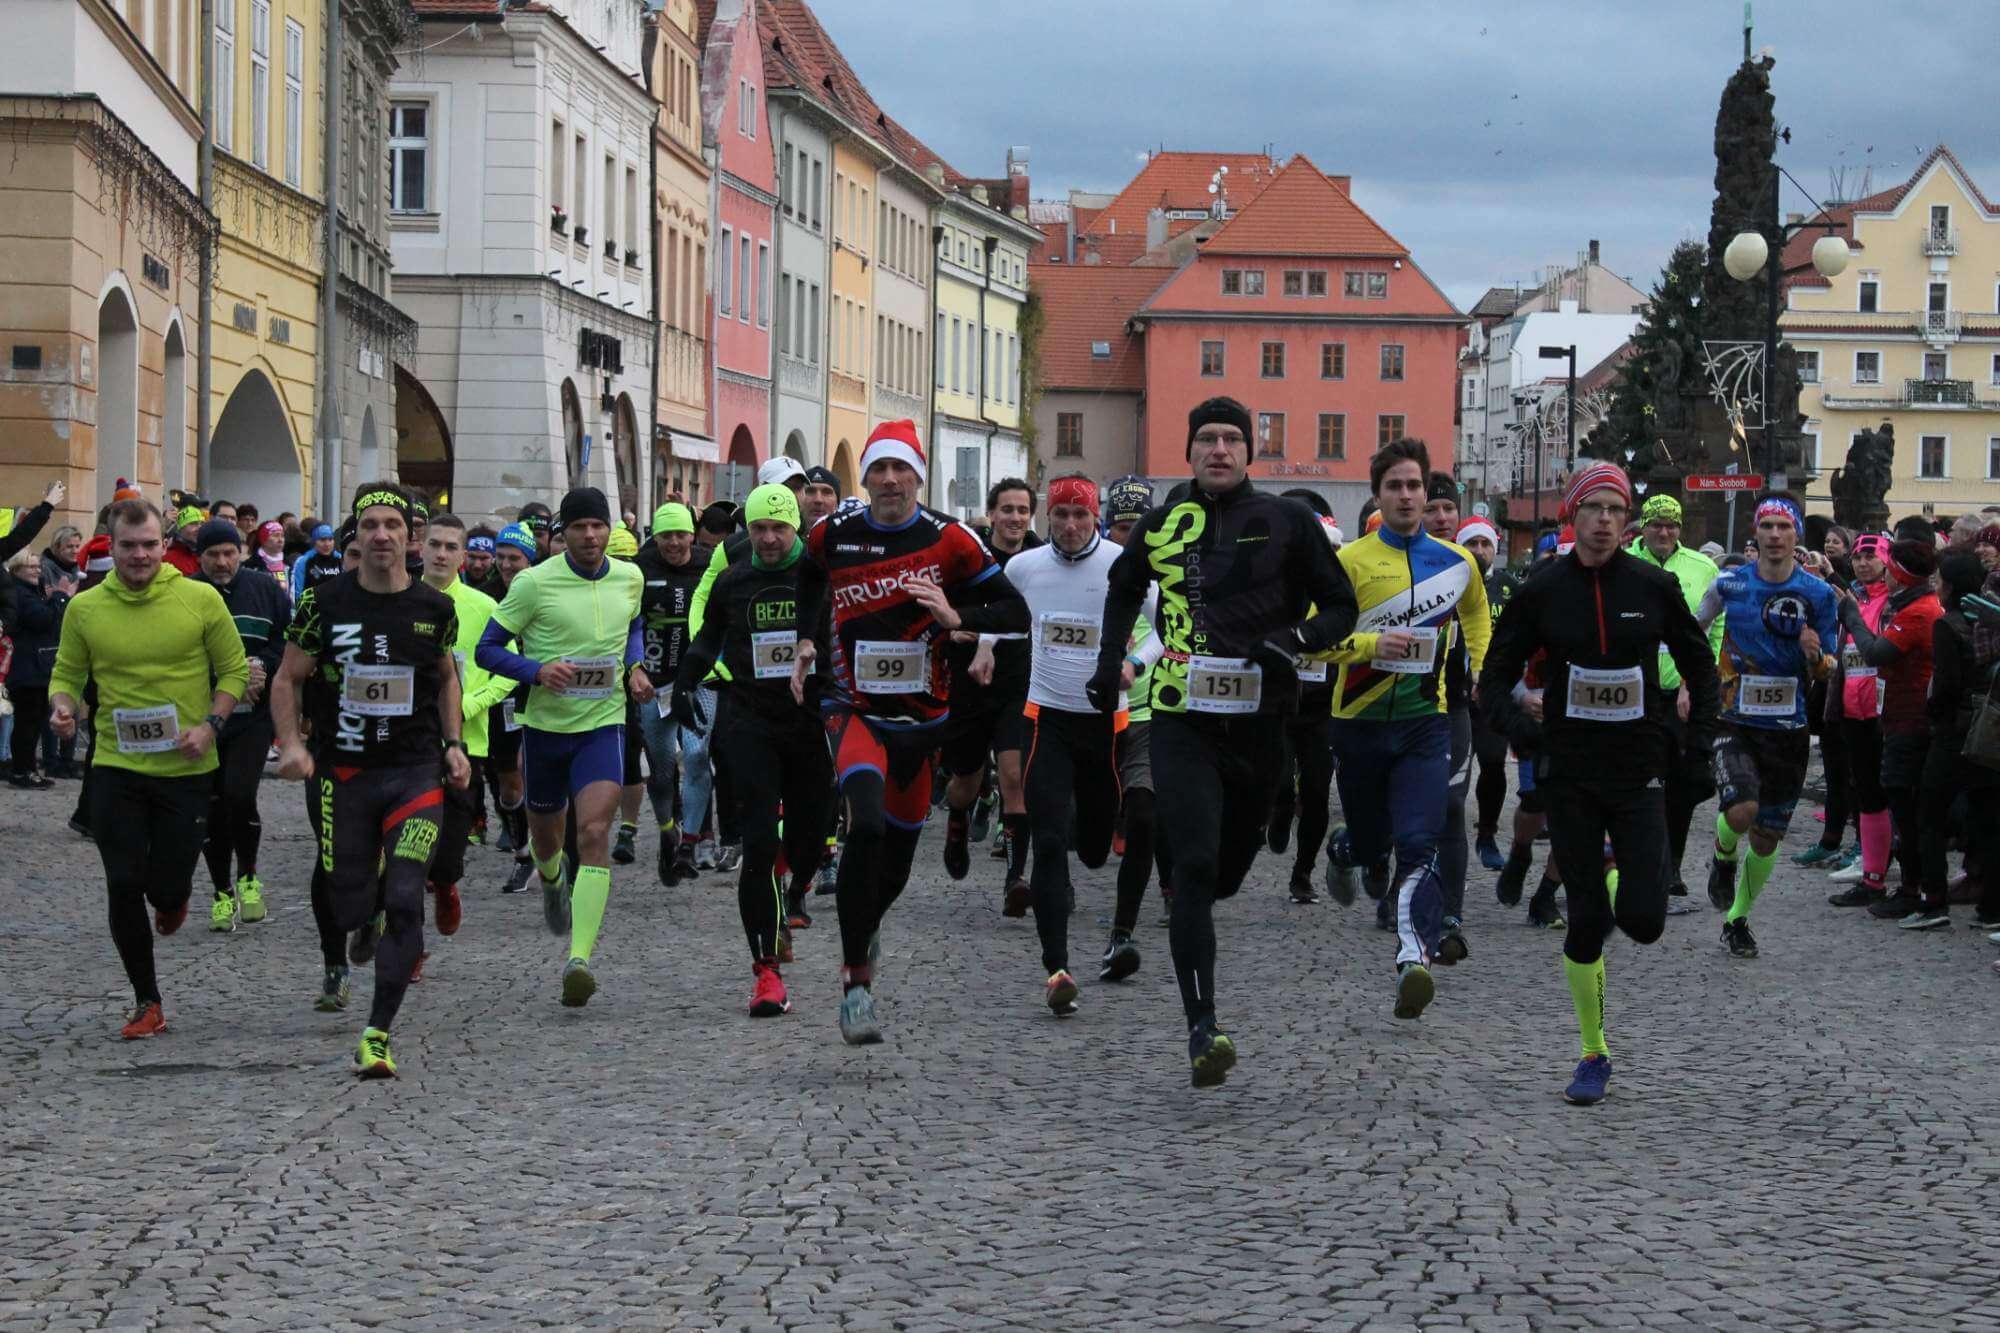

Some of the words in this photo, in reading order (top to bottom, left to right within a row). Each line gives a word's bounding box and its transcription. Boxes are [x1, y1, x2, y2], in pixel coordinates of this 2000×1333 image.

[1699, 479, 1716, 488] Nám.
[1719, 478, 1747, 488] Svobody
[674, 588, 684, 614] TEAM
[1052, 626, 1087, 645] 232
[771, 647, 795, 663] 62
[876, 659, 905, 678] 99
[575, 671, 605, 686] 172
[1206, 676, 1242, 697] 151
[365, 683, 389, 701] 61
[1586, 687, 1628, 705] 140
[1755, 689, 1783, 704] 155
[129, 722, 164, 739] 183
[399, 824, 438, 847] SWEEP
